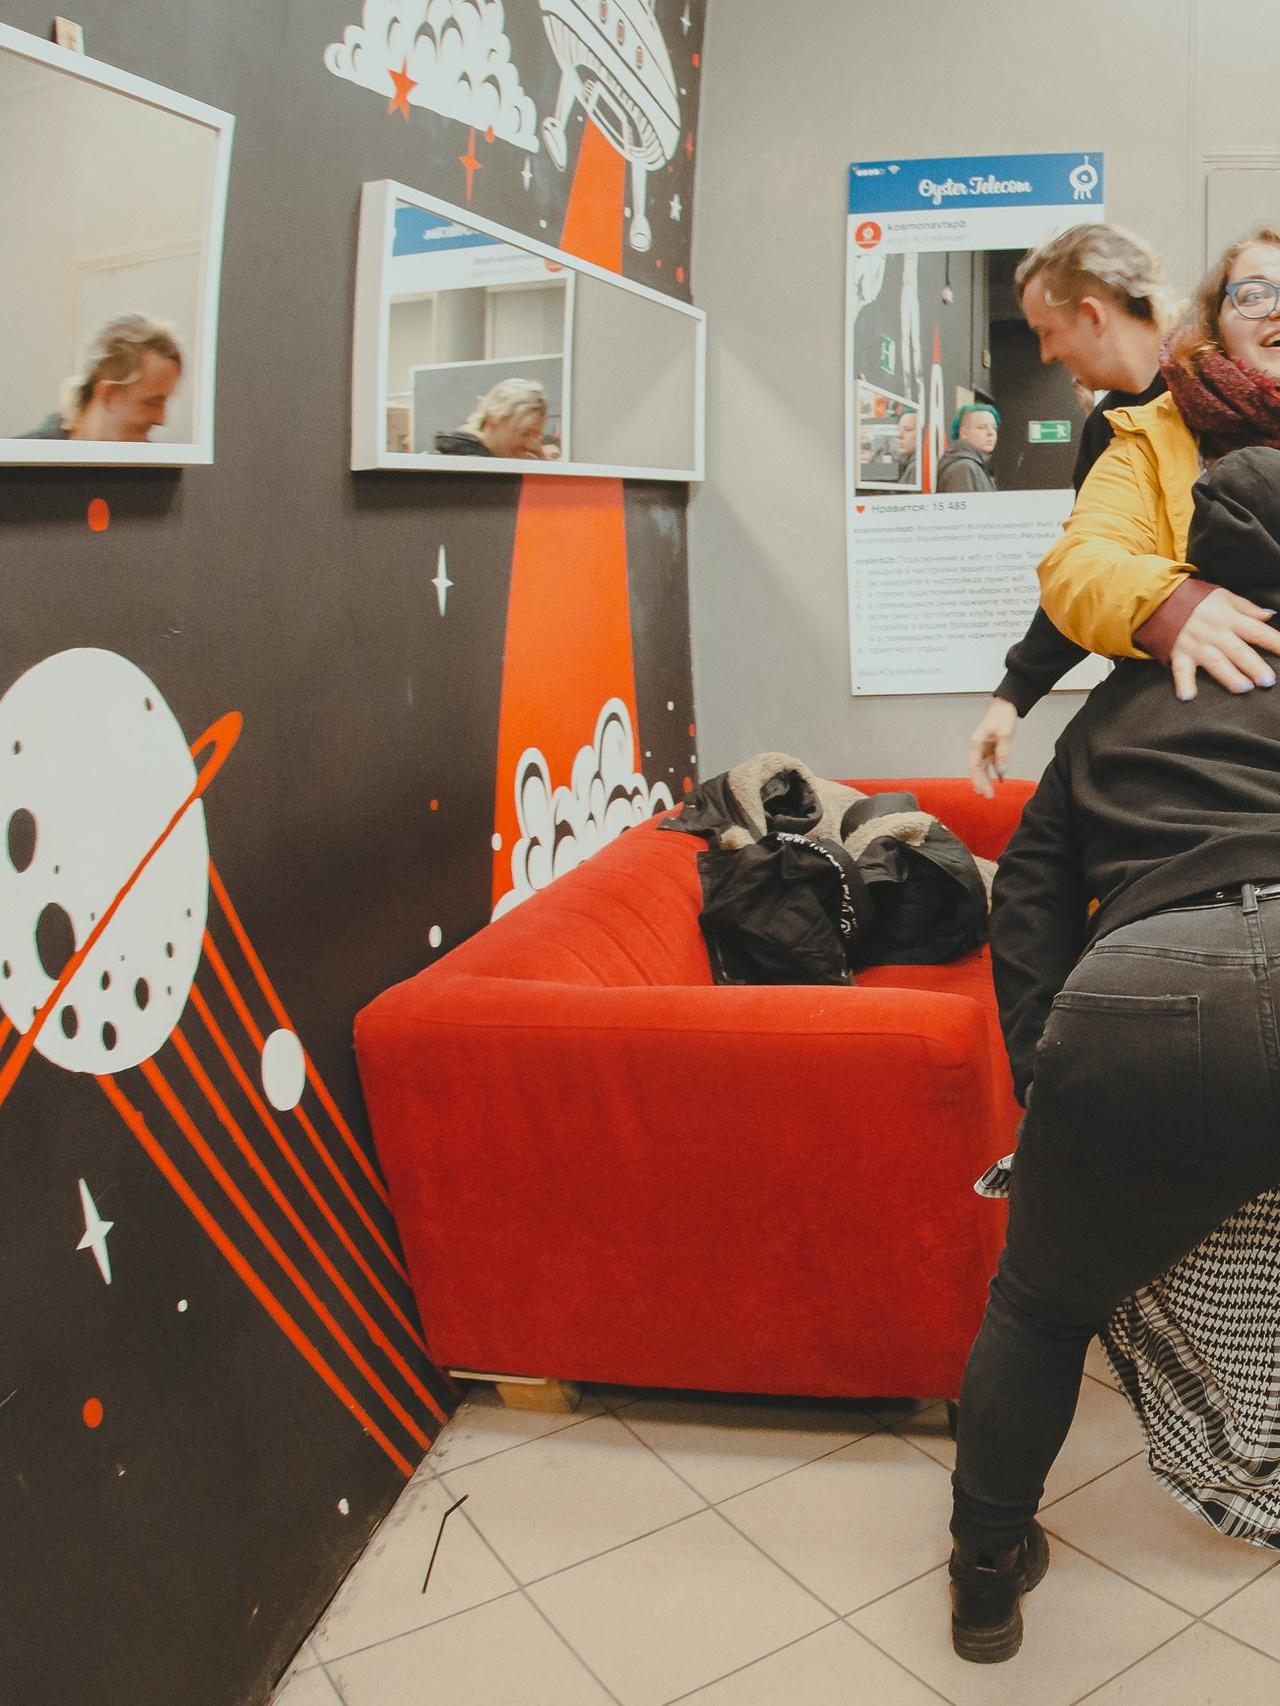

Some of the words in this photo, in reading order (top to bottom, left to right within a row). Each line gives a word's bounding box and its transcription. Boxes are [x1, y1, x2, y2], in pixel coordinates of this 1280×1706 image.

[918, 176, 968, 205] Oyster
[969, 174, 1033, 195] Telecom
[871, 504, 929, 515] Нравится:
[933, 502, 944, 511] 15
[948, 501, 967, 511] 485
